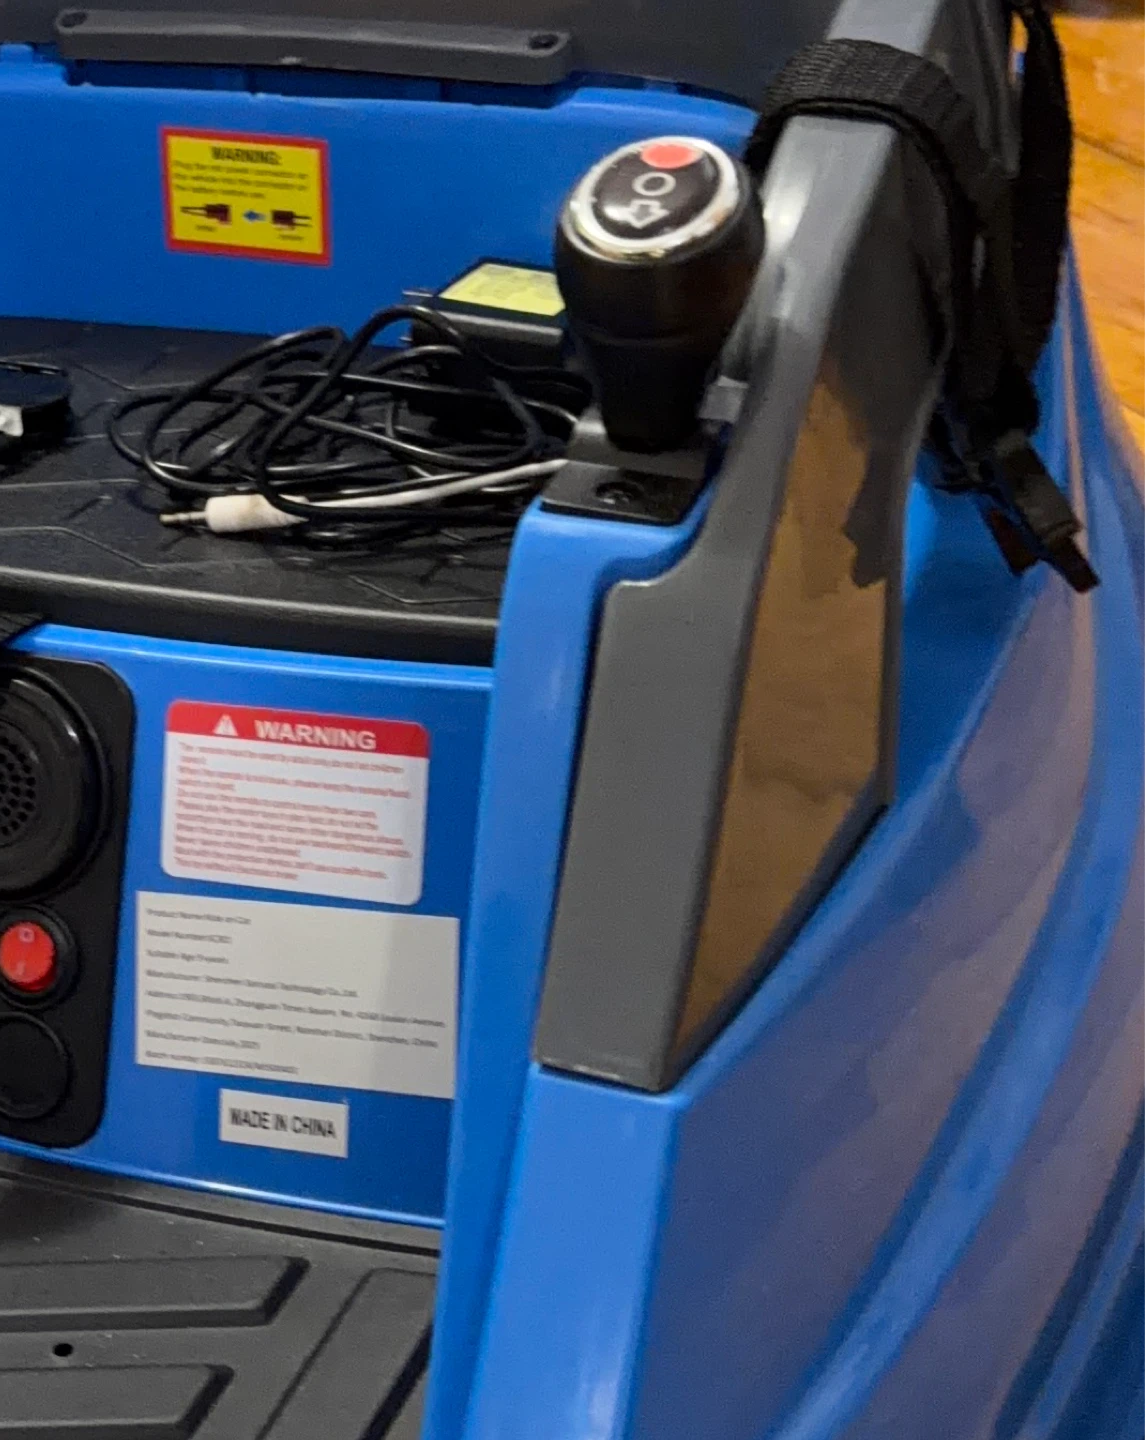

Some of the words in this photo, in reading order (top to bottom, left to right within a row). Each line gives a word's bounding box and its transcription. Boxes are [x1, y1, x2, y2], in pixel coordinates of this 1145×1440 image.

[254, 719, 377, 751] WARNING
[228, 1107, 271, 1131] MADE
[273, 1113, 289, 1133] IN
[290, 1115, 338, 1139] CHINA
